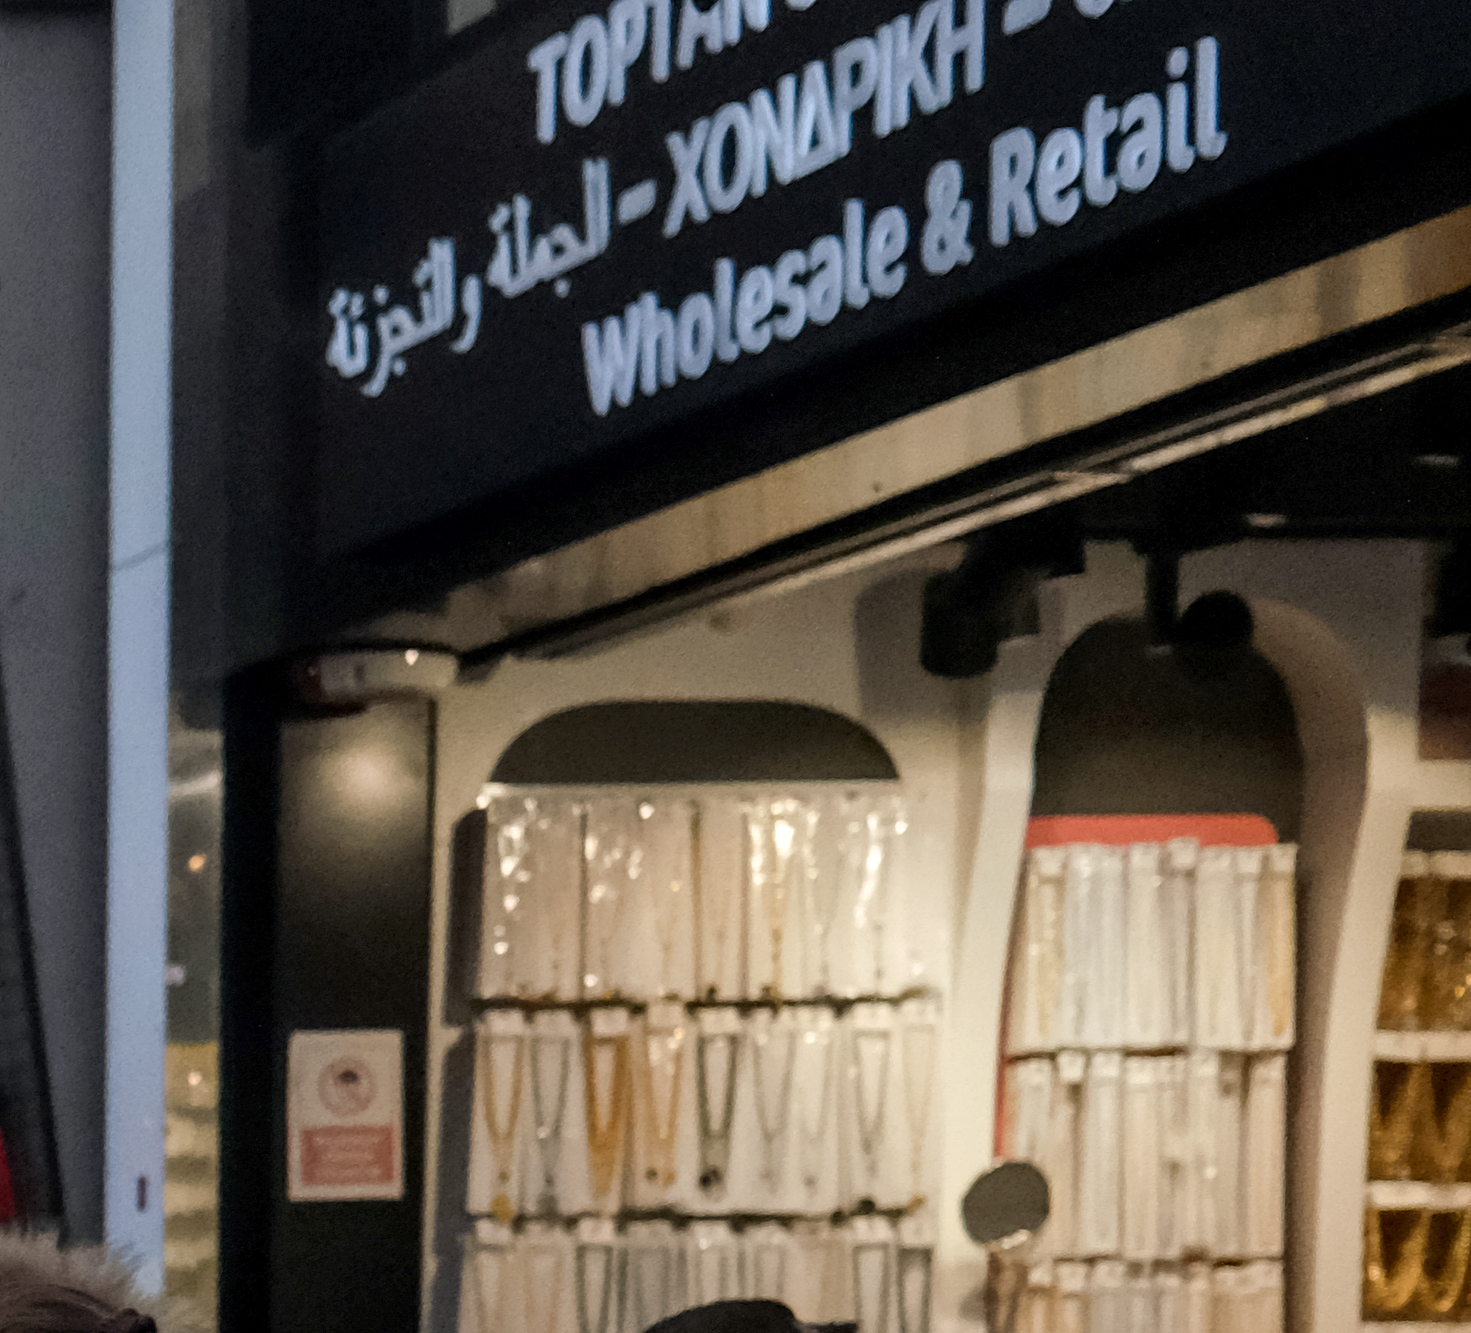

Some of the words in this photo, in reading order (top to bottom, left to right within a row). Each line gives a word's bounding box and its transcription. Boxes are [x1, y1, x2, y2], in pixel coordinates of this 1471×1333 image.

[581, 197, 910, 419] Wholesale
[919, 158, 975, 277] &
[988, 34, 1230, 249] Retail
